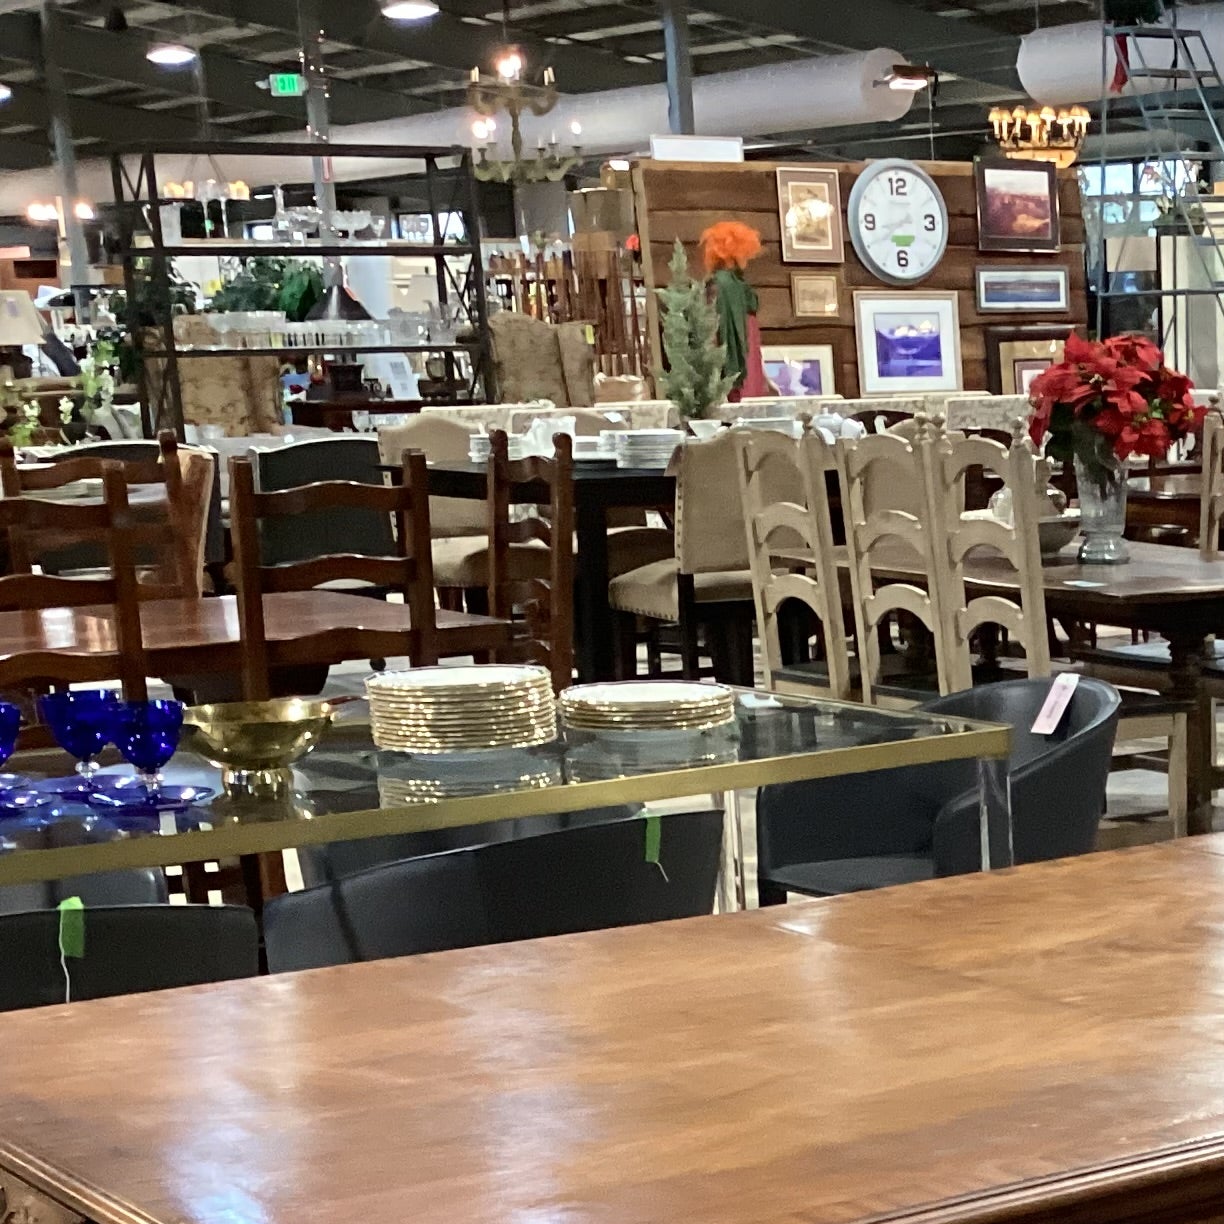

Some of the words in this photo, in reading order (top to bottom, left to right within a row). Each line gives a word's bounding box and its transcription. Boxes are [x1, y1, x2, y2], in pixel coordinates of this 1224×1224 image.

[888, 178, 907, 196] 12
[864, 214, 876, 231] 9
[924, 214, 936, 231] 3
[896, 250, 909, 267] 6
